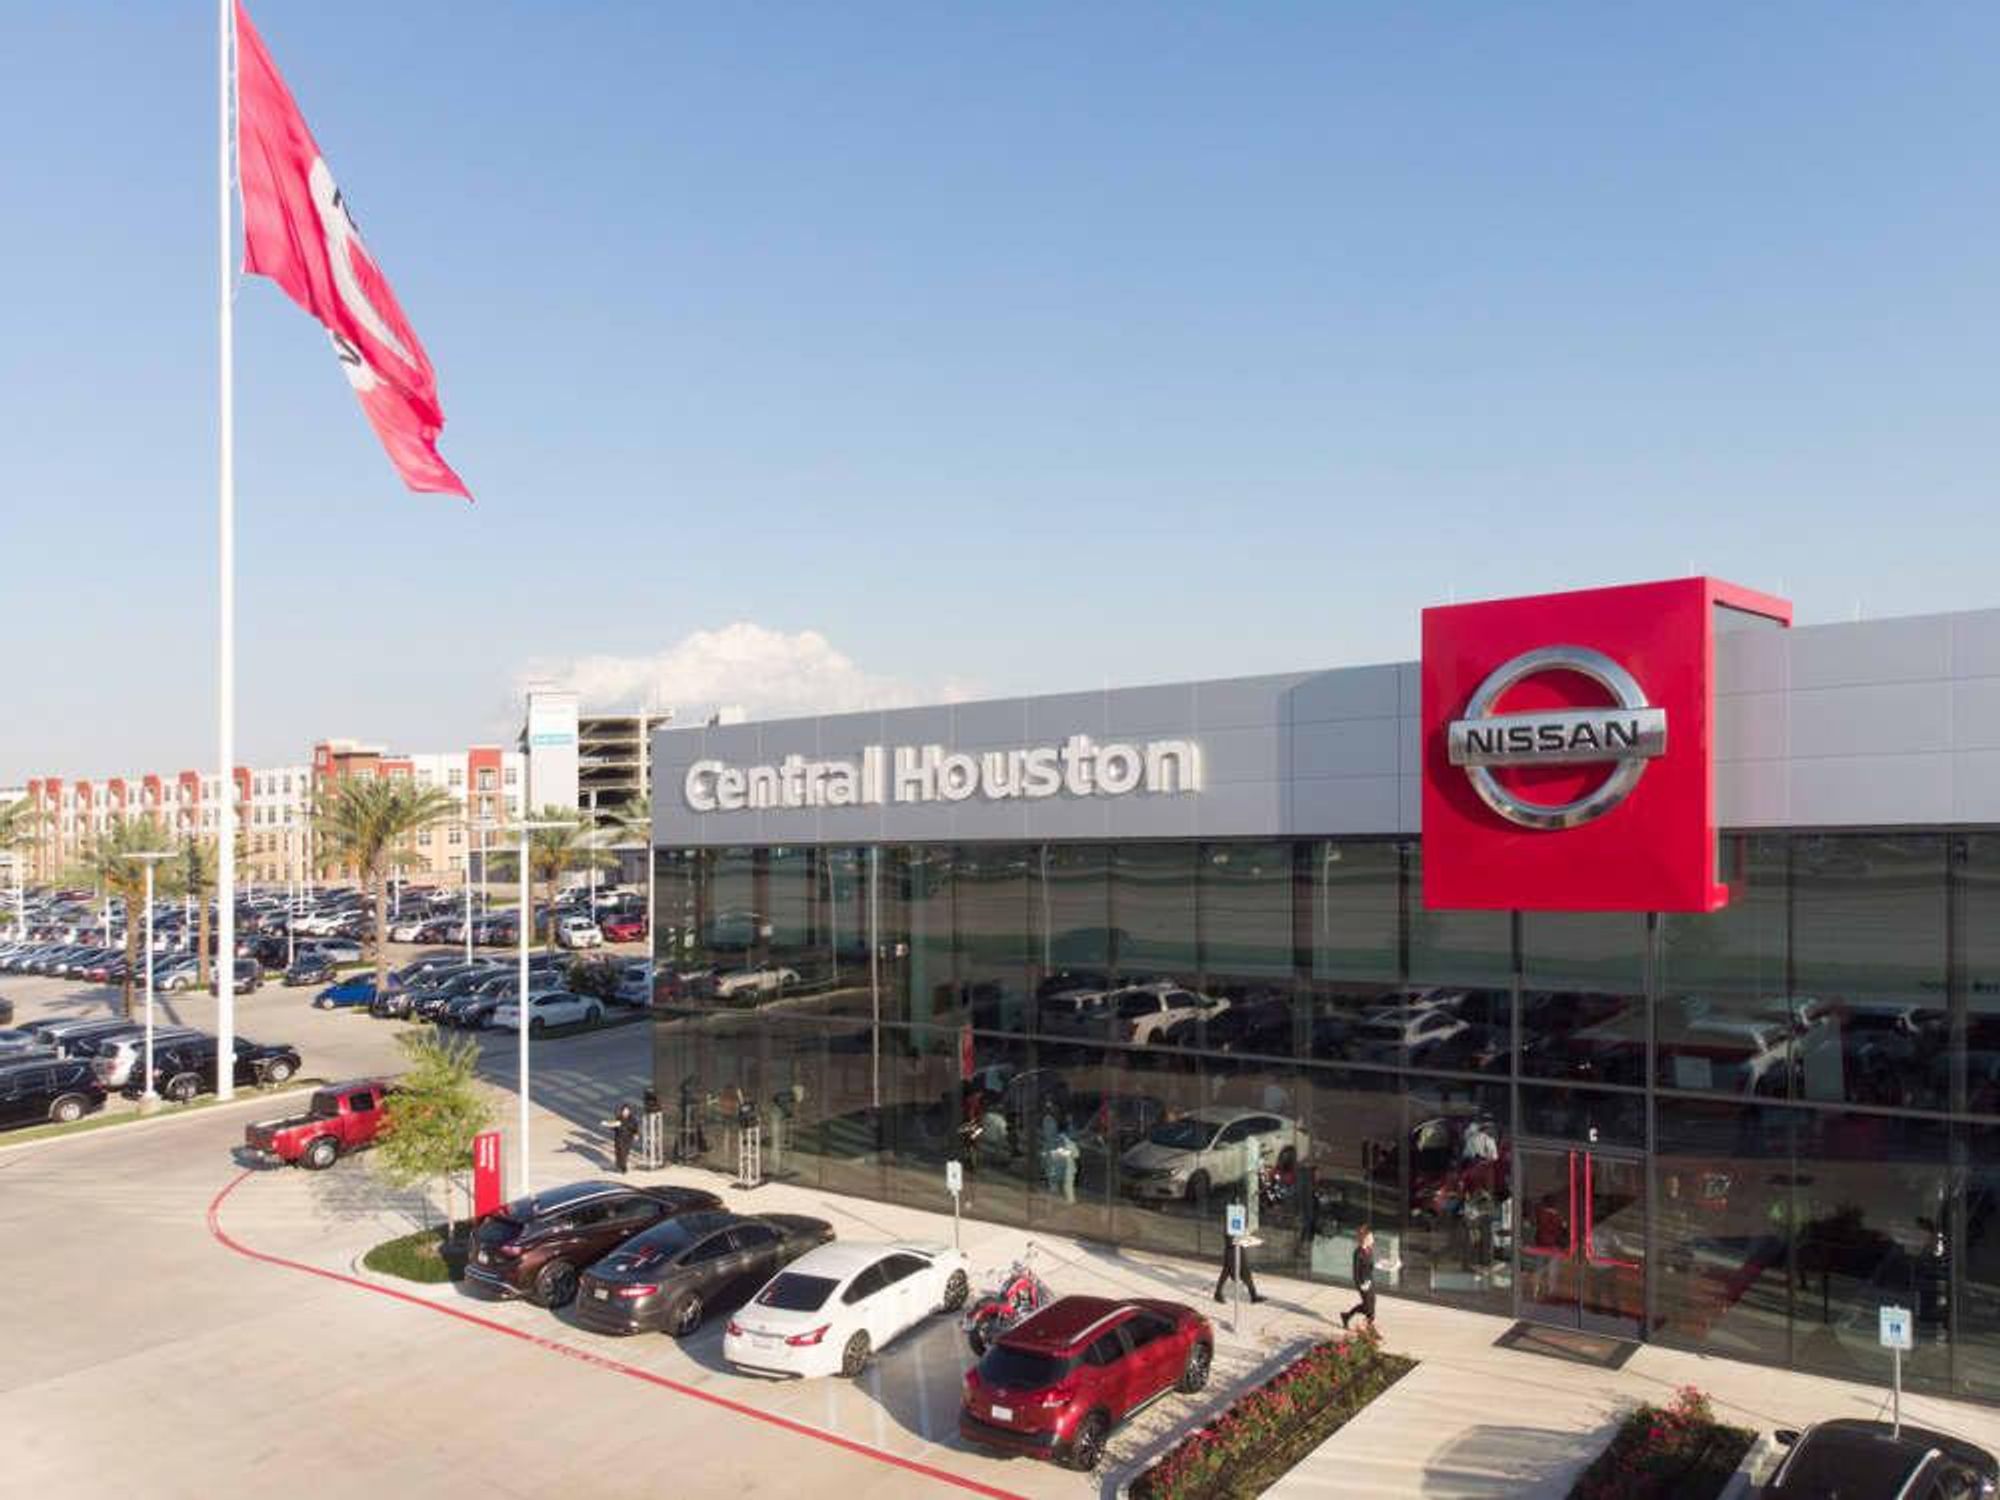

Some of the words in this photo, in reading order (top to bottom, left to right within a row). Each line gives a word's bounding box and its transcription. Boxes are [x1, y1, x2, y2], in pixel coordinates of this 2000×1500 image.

[1466, 719, 1639, 754] NISSAN
[685, 745, 883, 811] Central
[894, 734, 1204, 802] Houston
